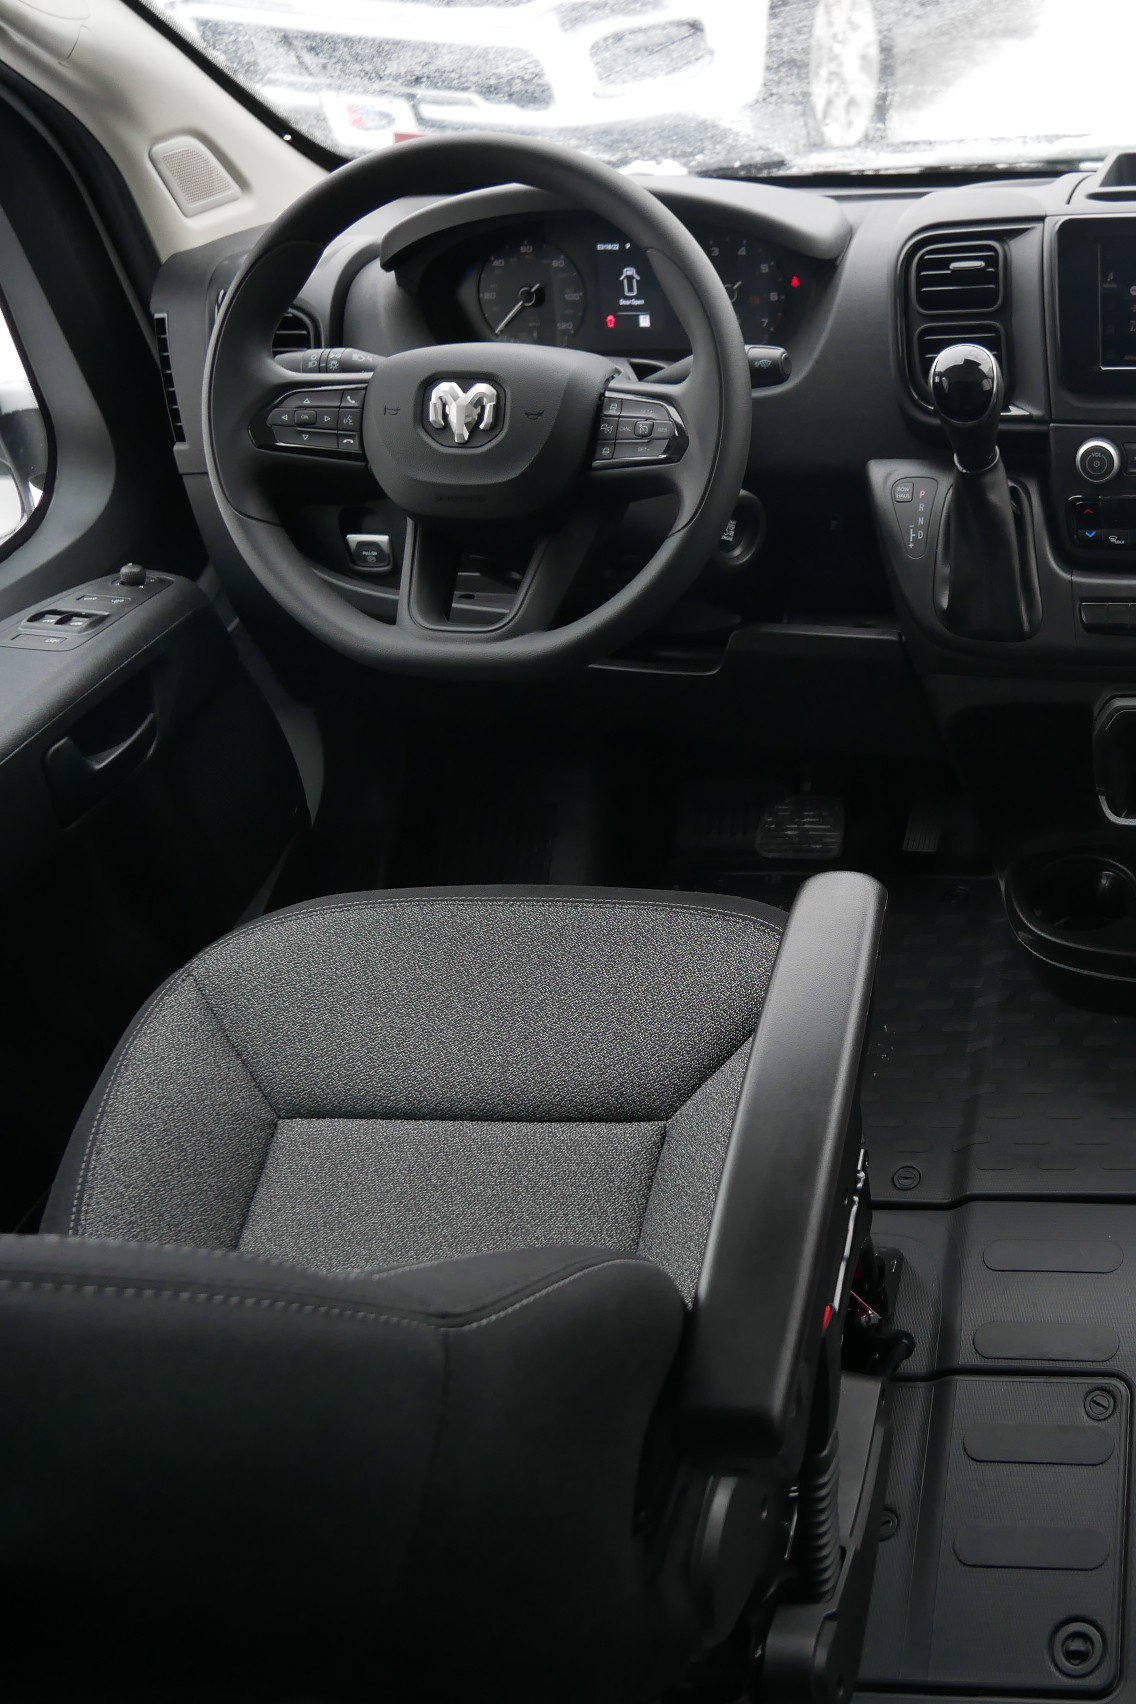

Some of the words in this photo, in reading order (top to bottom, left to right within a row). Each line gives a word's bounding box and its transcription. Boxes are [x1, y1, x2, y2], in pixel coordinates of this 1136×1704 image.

[710, 246, 719, 256] 3
[737, 246, 746, 256] 4
[760, 264, 769, 273] 5
[761, 318, 769, 327] 7
[919, 490, 926, 499] P
[919, 504, 925, 512] R
[918, 517, 924, 526] N
[918, 531, 924, 540] D
